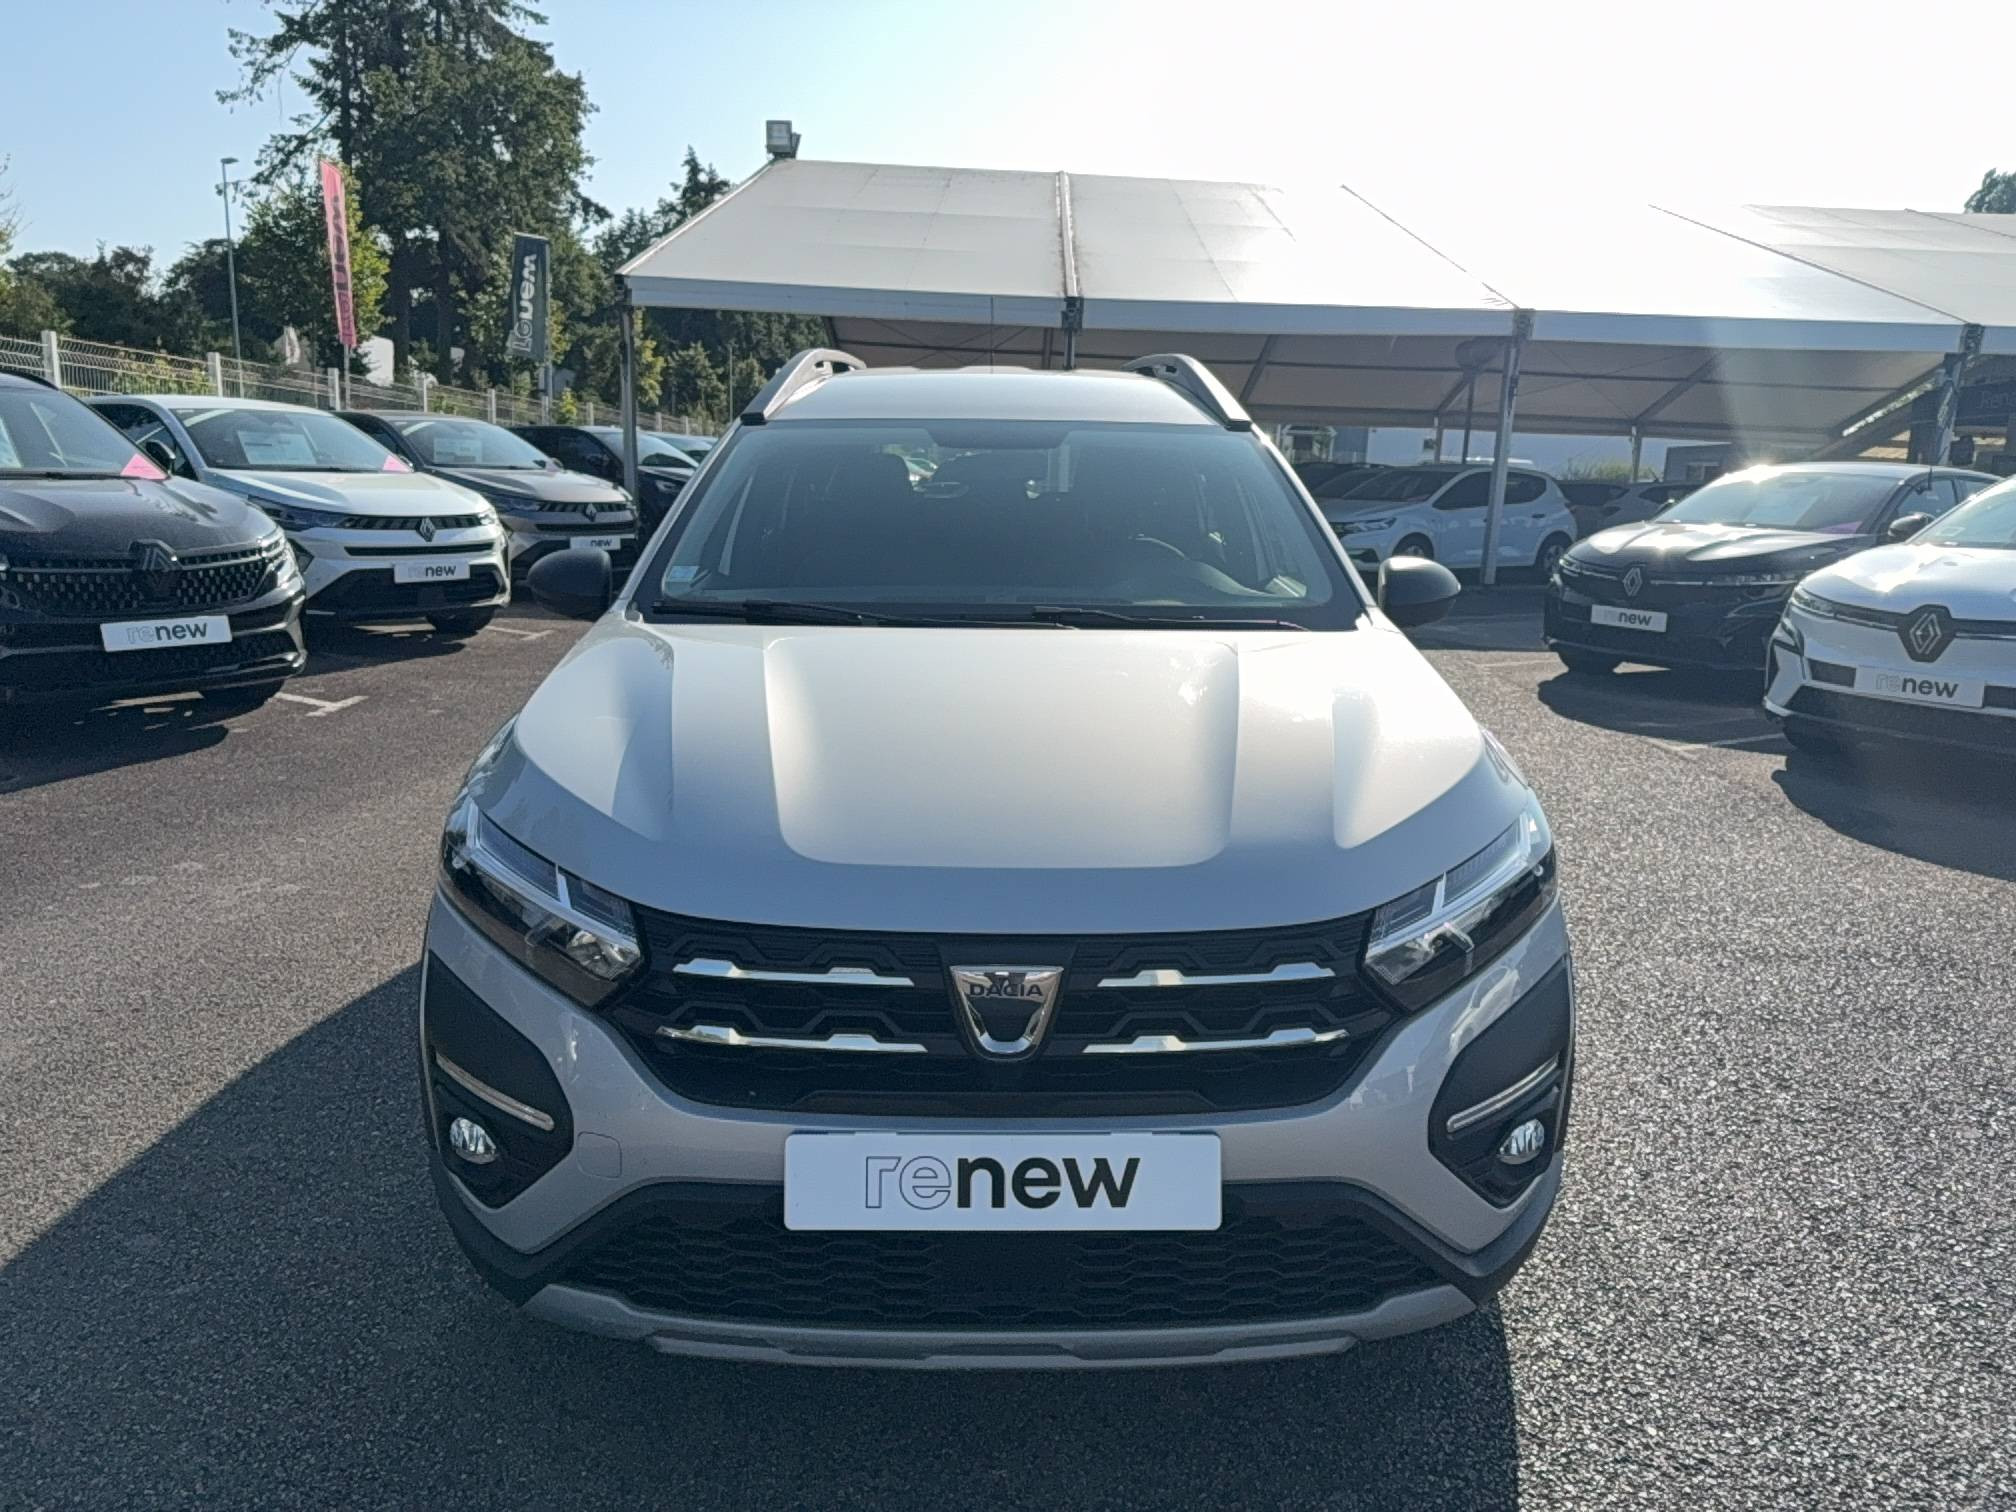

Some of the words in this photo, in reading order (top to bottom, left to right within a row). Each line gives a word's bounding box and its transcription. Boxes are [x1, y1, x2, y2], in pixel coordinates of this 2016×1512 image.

[126, 622, 207, 645] renew
[970, 983, 1044, 997] DACIA
[865, 1155, 1140, 1210] renew
